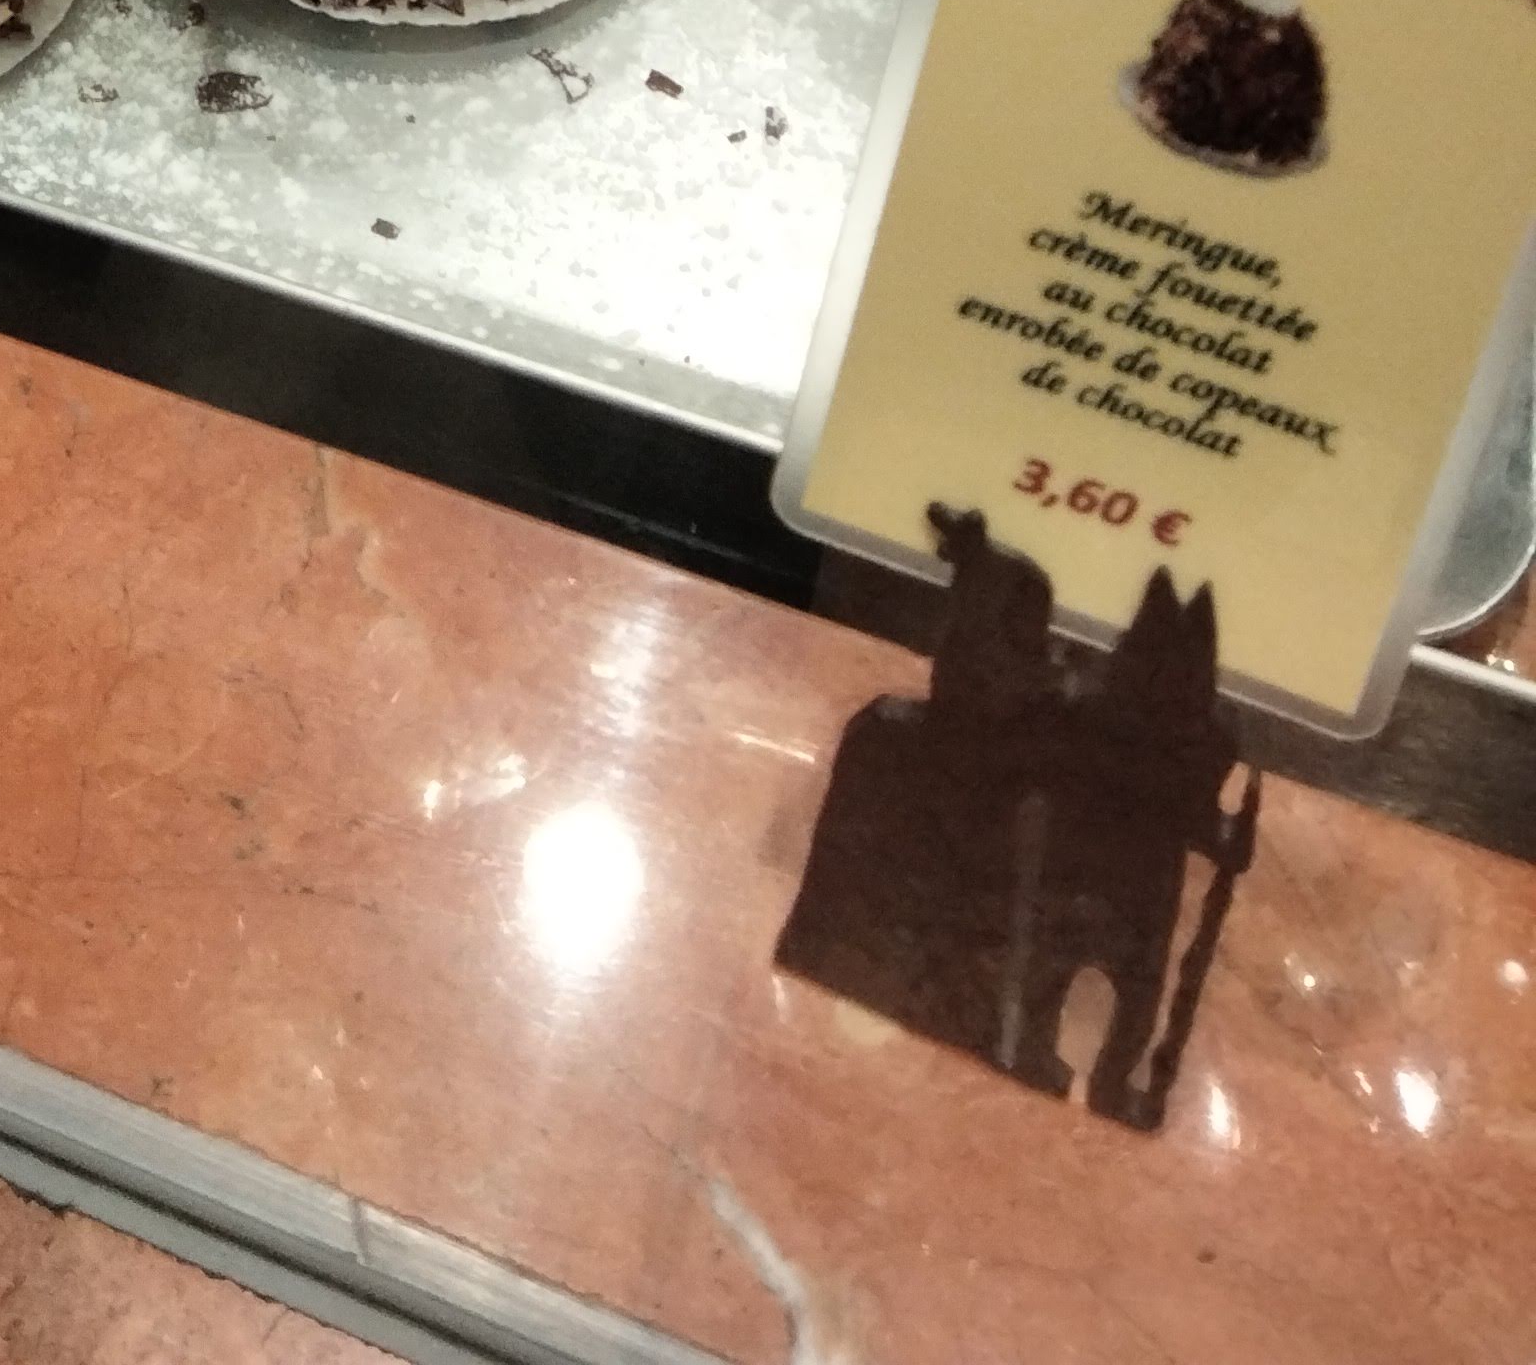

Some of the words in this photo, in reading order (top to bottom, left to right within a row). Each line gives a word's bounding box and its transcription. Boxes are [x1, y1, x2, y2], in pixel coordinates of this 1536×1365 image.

[1027, 227, 1141, 280] crème
[1134, 261, 1319, 342] fouettée
[1079, 190, 1282, 290] Meringue,
[958, 295, 1106, 362] enrobée
[1112, 346, 1162, 382] de
[1168, 371, 1338, 457] copeaux
[1042, 279, 1096, 314] au
[1104, 299, 1272, 375] chocolat
[1020, 359, 1068, 395] de
[1075, 382, 1243, 457] chocolat
[1013, 457, 1139, 527] 3,60
[1152, 510, 1193, 547] €
